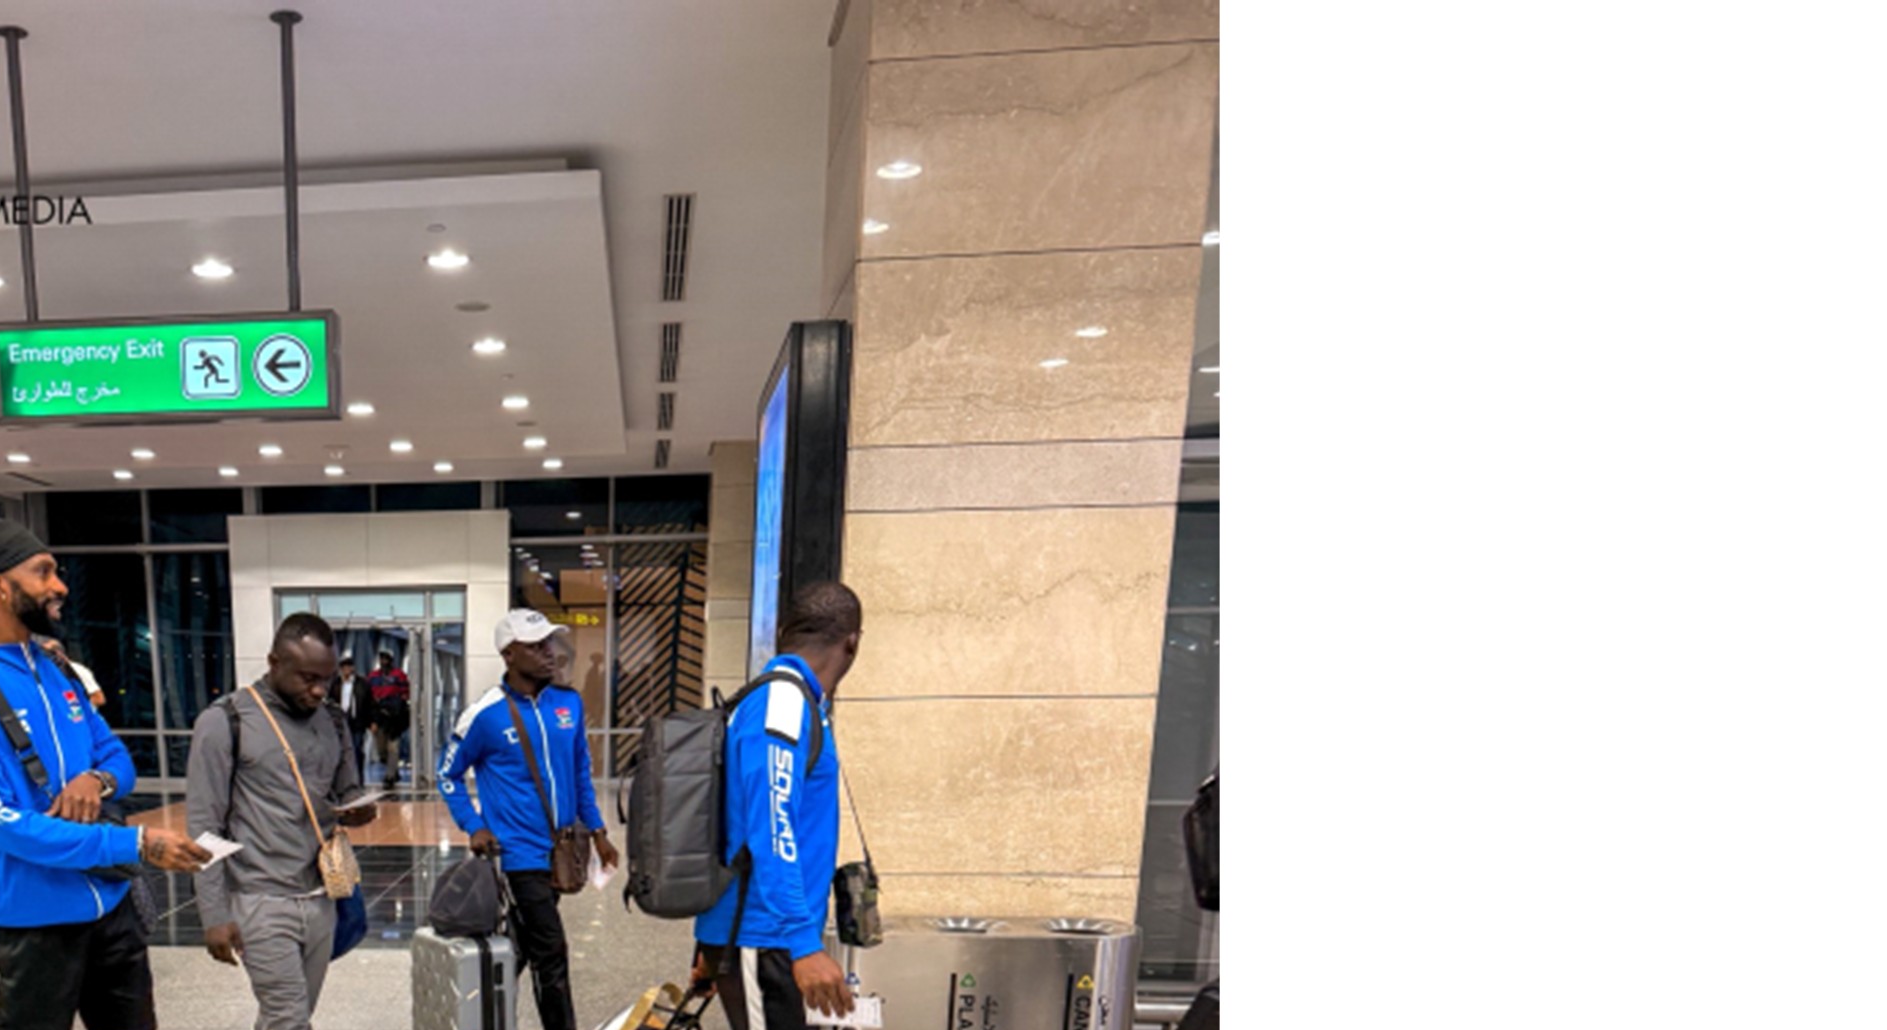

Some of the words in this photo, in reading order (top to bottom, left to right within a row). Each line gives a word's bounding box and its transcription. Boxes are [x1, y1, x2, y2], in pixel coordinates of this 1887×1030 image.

[8, 342, 121, 366] Emergency
[125, 338, 165, 359] Exit
[76, 381, 121, 406] مخرج
[773, 744, 798, 863] SQUAD
